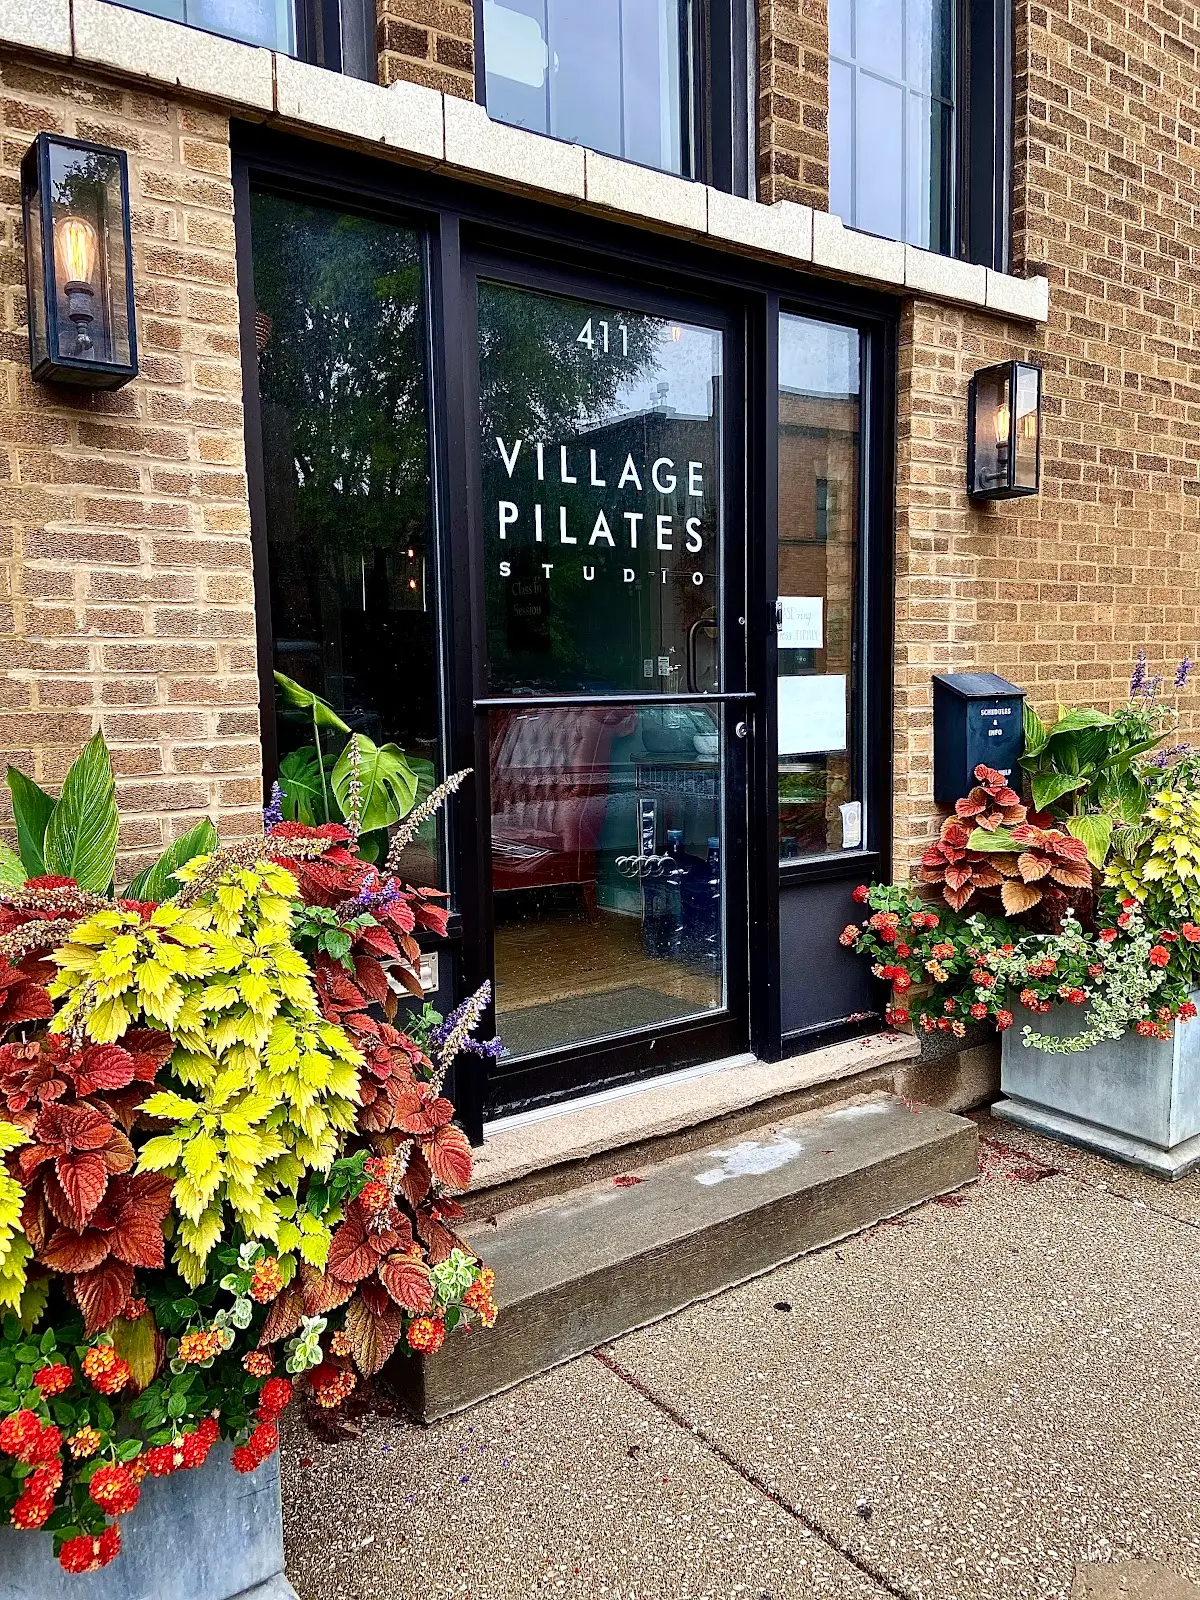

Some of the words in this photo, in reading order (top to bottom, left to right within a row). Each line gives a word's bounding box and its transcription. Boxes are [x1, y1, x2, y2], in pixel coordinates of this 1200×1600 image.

[576, 318, 628, 356] 411
[495, 436, 704, 497] VILLAGE
[498, 500, 703, 553] PILATES
[499, 561, 704, 586] STUDIO
[511, 581, 533, 596] Class
[513, 603, 542, 617] Session
[980, 708, 1011, 716] SCHEDULES
[988, 729, 1002, 737] INFO
